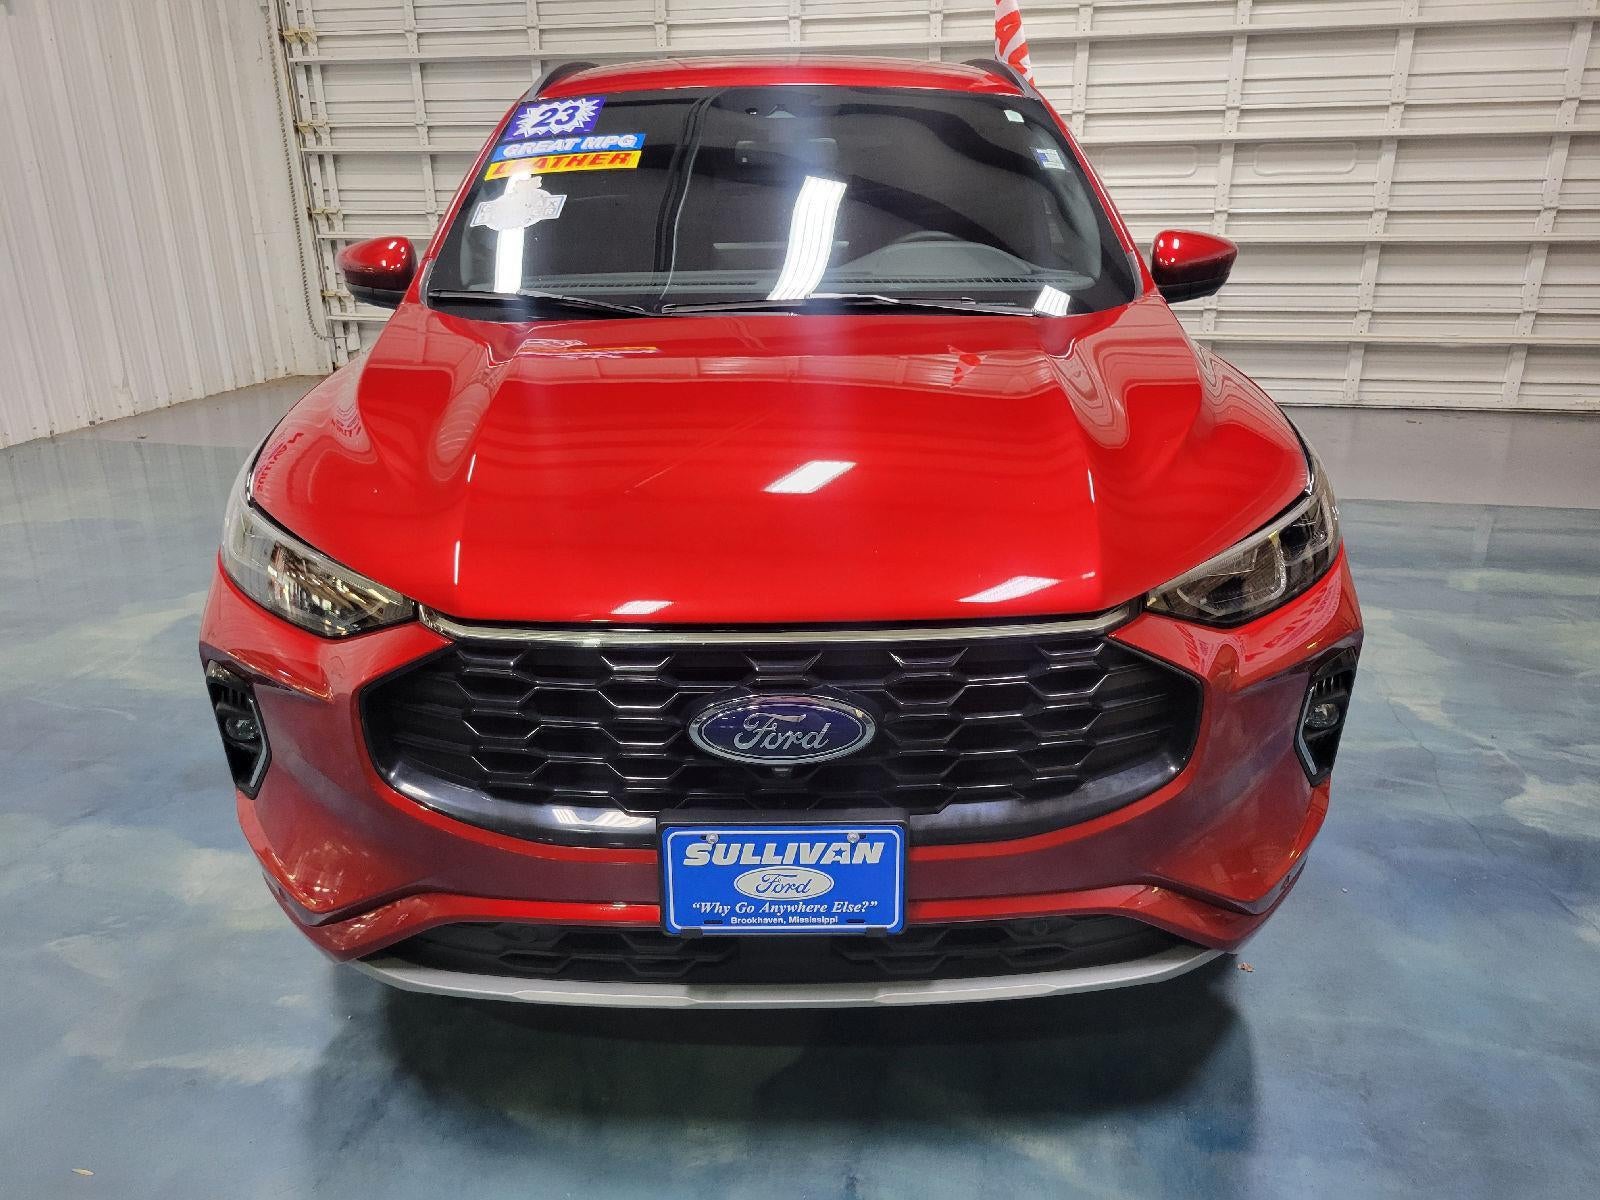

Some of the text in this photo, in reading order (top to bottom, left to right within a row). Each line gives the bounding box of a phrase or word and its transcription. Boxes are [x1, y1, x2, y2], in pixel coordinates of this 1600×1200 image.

[531, 105, 581, 129] 23
[503, 134, 638, 157] GREAT MPG
[493, 153, 632, 176] LATHER
[733, 712, 832, 750] Ford
[683, 842, 885, 866] SULLIVAN
[755, 873, 811, 894] Ford
[735, 902, 755, 913] Go
[759, 902, 827, 915] Anywhere
[730, 916, 838, 925] Brookhaven, Mississippi
